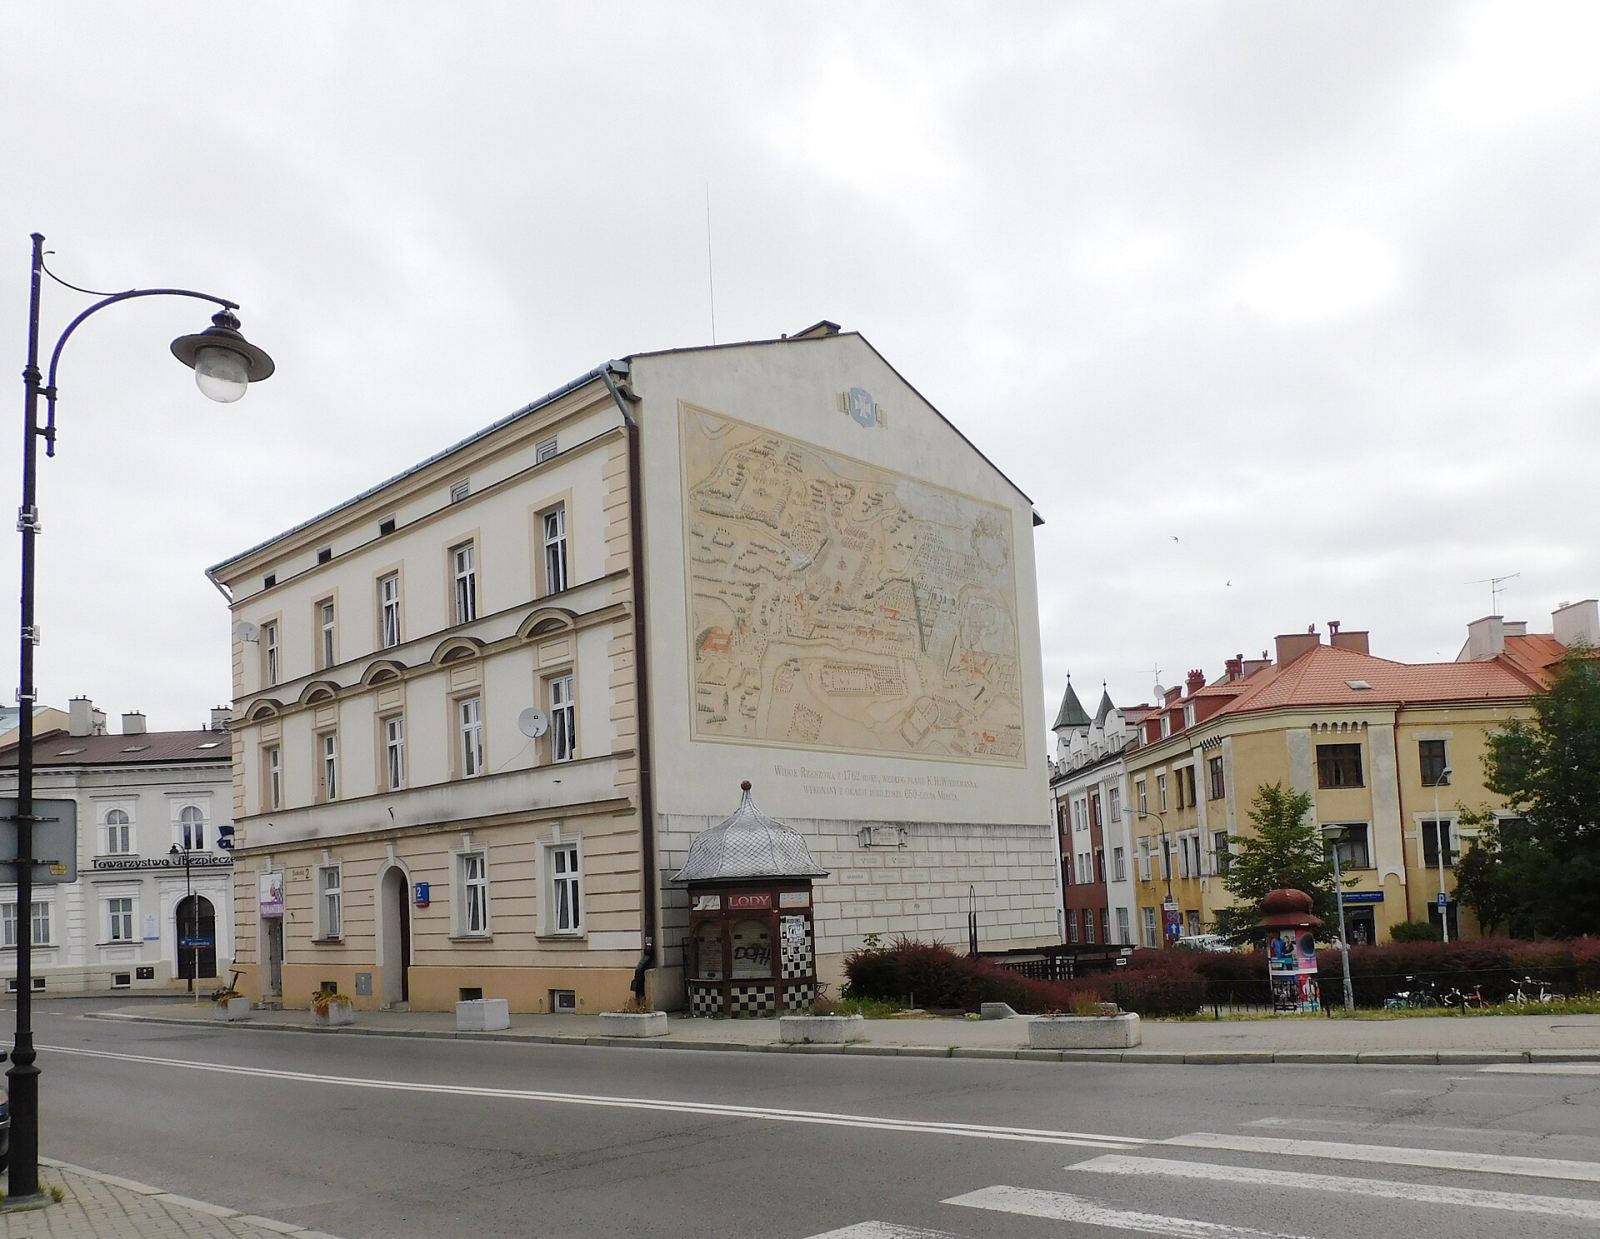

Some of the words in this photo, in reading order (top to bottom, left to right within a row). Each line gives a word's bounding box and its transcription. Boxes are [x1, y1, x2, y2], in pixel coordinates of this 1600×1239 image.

[843, 769, 860, 781] 1762
[91, 858, 170, 869] Towarzystwo
[305, 868, 310, 879] 2
[416, 887, 422, 897] 2
[729, 896, 770, 906] LODY
